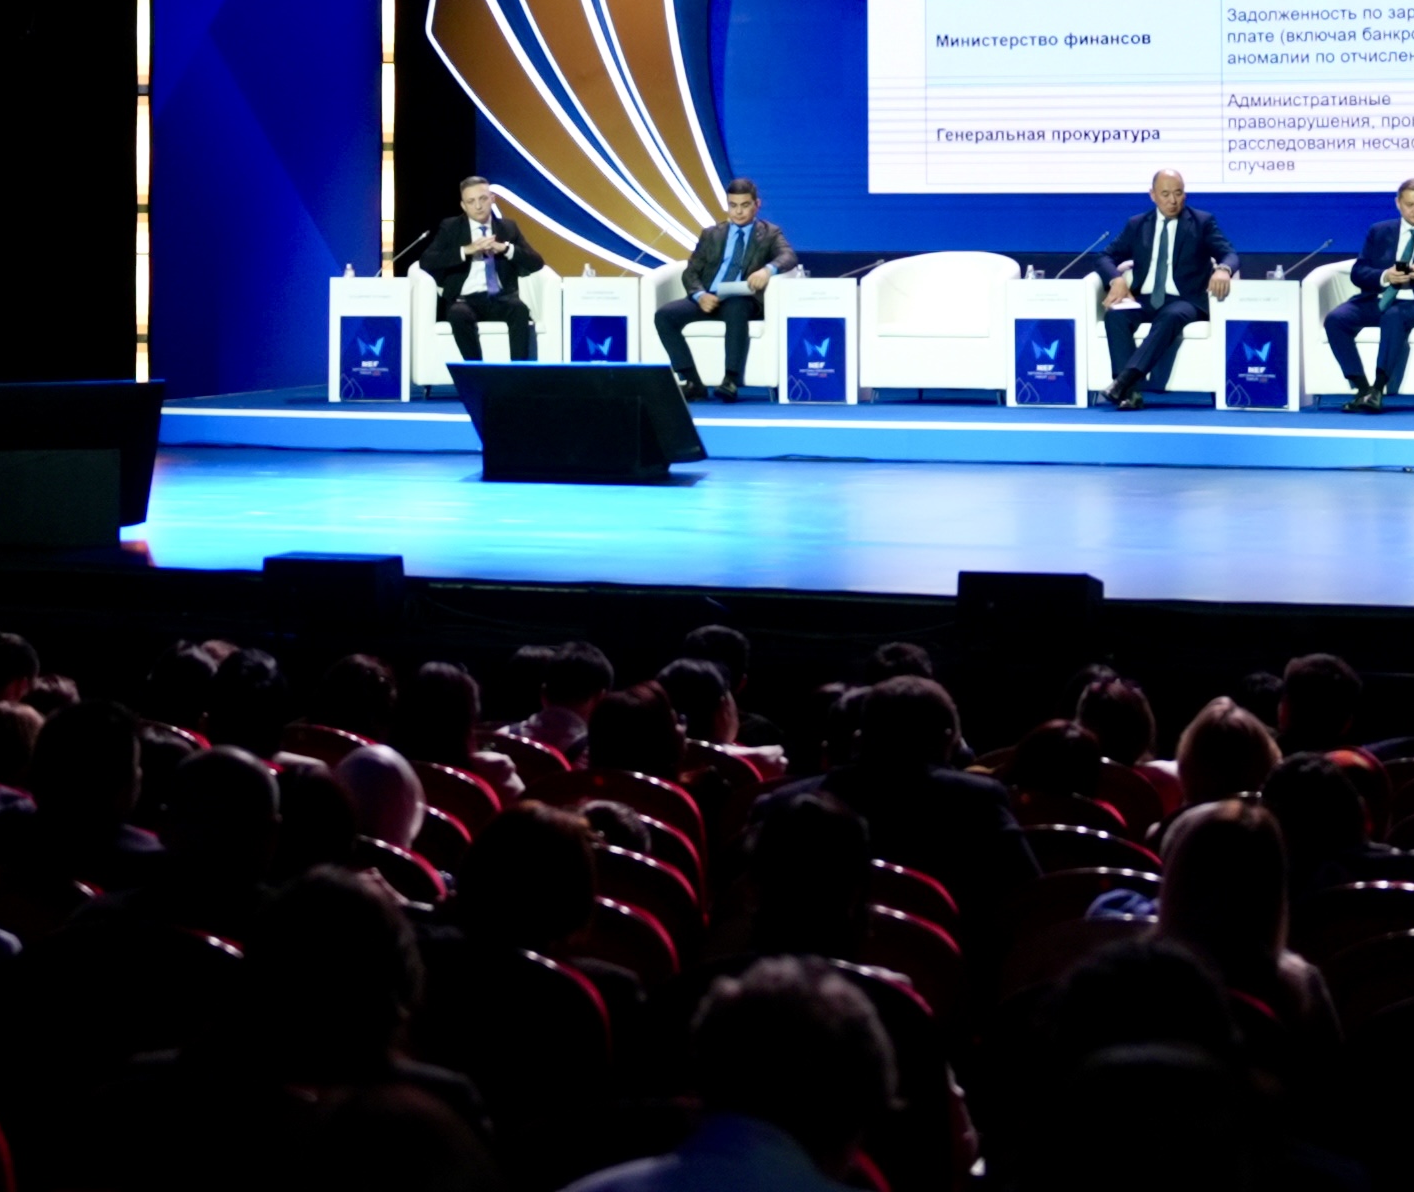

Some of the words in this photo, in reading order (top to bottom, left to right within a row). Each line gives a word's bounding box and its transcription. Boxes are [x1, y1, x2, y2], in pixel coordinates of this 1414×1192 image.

[1227, 7, 1357, 23] Задолженность
[1362, 8, 1383, 20] по
[935, 33, 1058, 49] Министерство
[1064, 32, 1152, 49] финансов
[1227, 31, 1275, 44] плате
[1280, 28, 1357, 45] (включая
[1227, 52, 1310, 65] аномалии
[1315, 51, 1336, 64] по
[1227, 93, 1392, 110] Административные
[936, 128, 1046, 143] Генеральная
[1051, 127, 1161, 143] прокуратура
[1228, 136, 1356, 153] расследования
[1228, 159, 1296, 175] случаев
